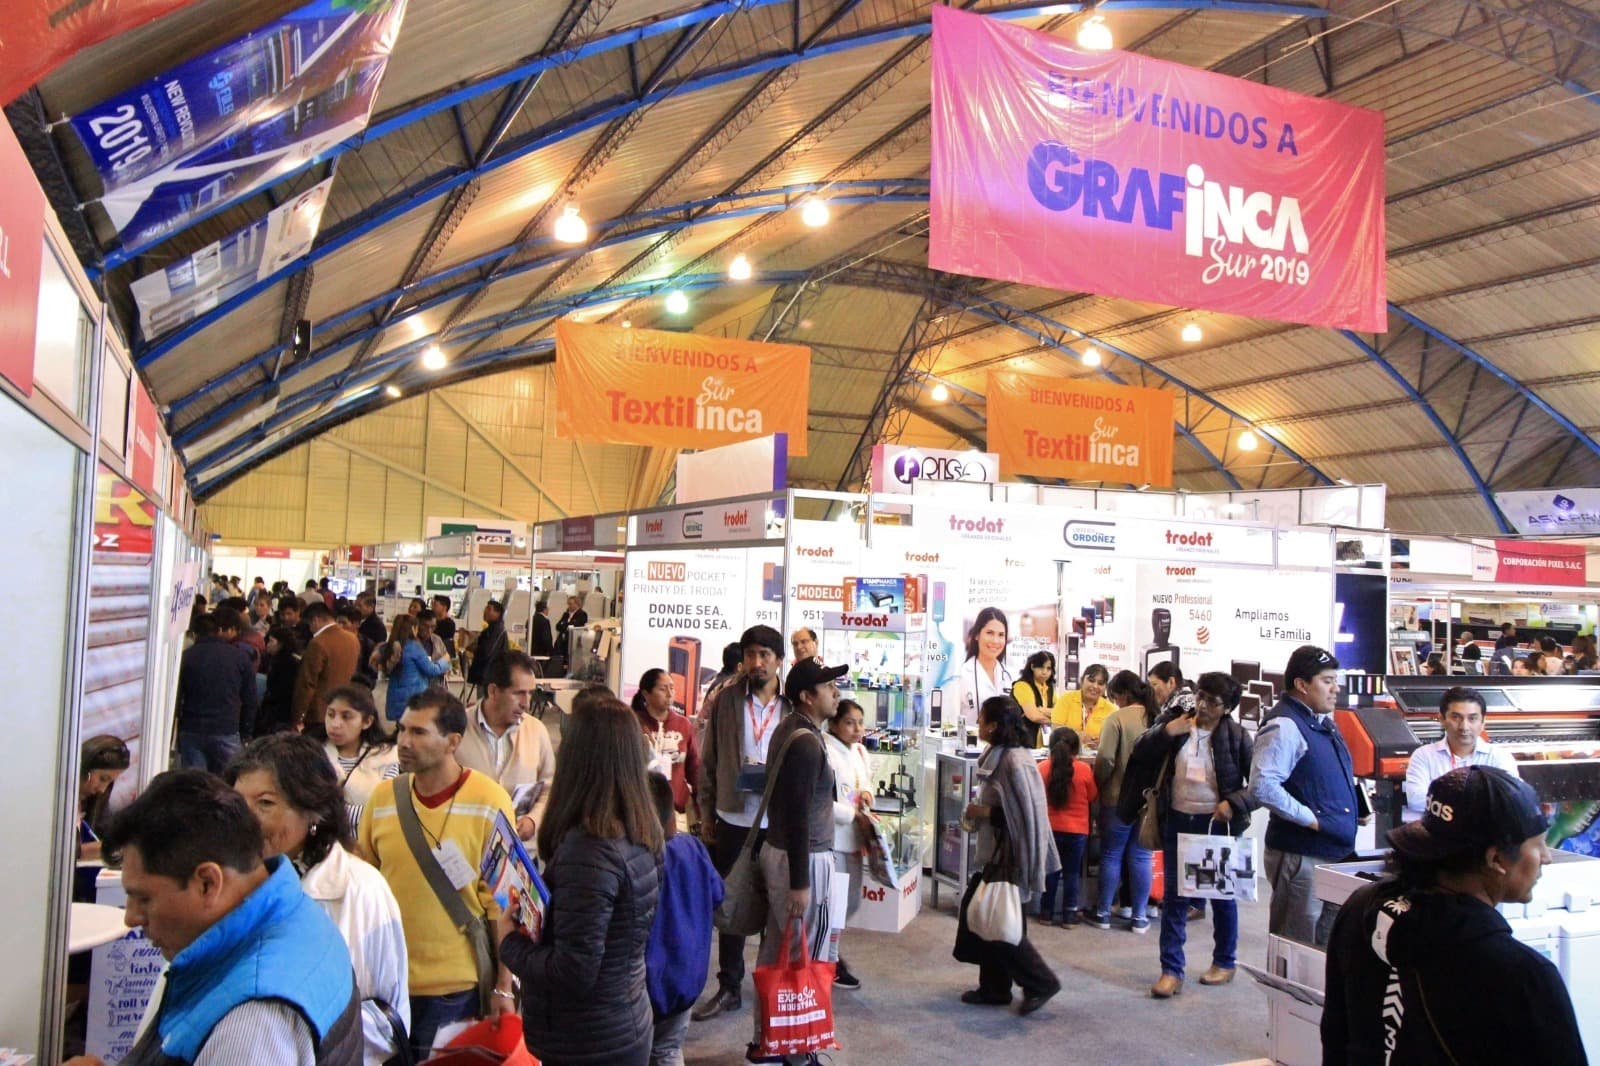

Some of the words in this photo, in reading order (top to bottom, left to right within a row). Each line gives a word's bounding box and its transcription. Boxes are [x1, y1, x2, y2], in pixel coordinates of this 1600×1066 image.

[1047, 69, 1268, 150] BIENVENIDOS
[1277, 124, 1299, 156] A
[88, 104, 152, 172] 2019
[1201, 238, 1257, 285] Sur
[1260, 258, 1309, 286] 2019
[744, 357, 758, 373] A
[696, 376, 735, 406] Sur
[1030, 388, 1123, 412] BIENVENIDOS
[1125, 400, 1135, 414] A
[1090, 416, 1119, 442] Sur
[723, 510, 748, 526] trodat
[949, 514, 1004, 533] trodat
[1165, 529, 1213, 546] trodat
[796, 545, 834, 558] trodat
[905, 551, 940, 563] trodat
[633, 568, 646, 579] EL
[649, 562, 684, 580] NUEVO
[687, 570, 726, 582] POCKET
[1166, 565, 1197, 576] trodat
[633, 583, 671, 595] PRINTY
[673, 585, 686, 595] DE
[690, 585, 728, 597] TRODAT
[1152, 594, 1173, 604] NUEVO
[649, 603, 692, 615] DONDE
[696, 605, 724, 617] SEA.
[756, 610, 778, 621] 9511
[1189, 609, 1212, 621] 5460
[1234, 608, 1289, 622] Ampliamos
[648, 617, 701, 630] CUANDO
[703, 619, 732, 631] SEA.
[840, 613, 889, 628] trodat
[1259, 626, 1271, 638] La
[1274, 627, 1311, 641] Familia
